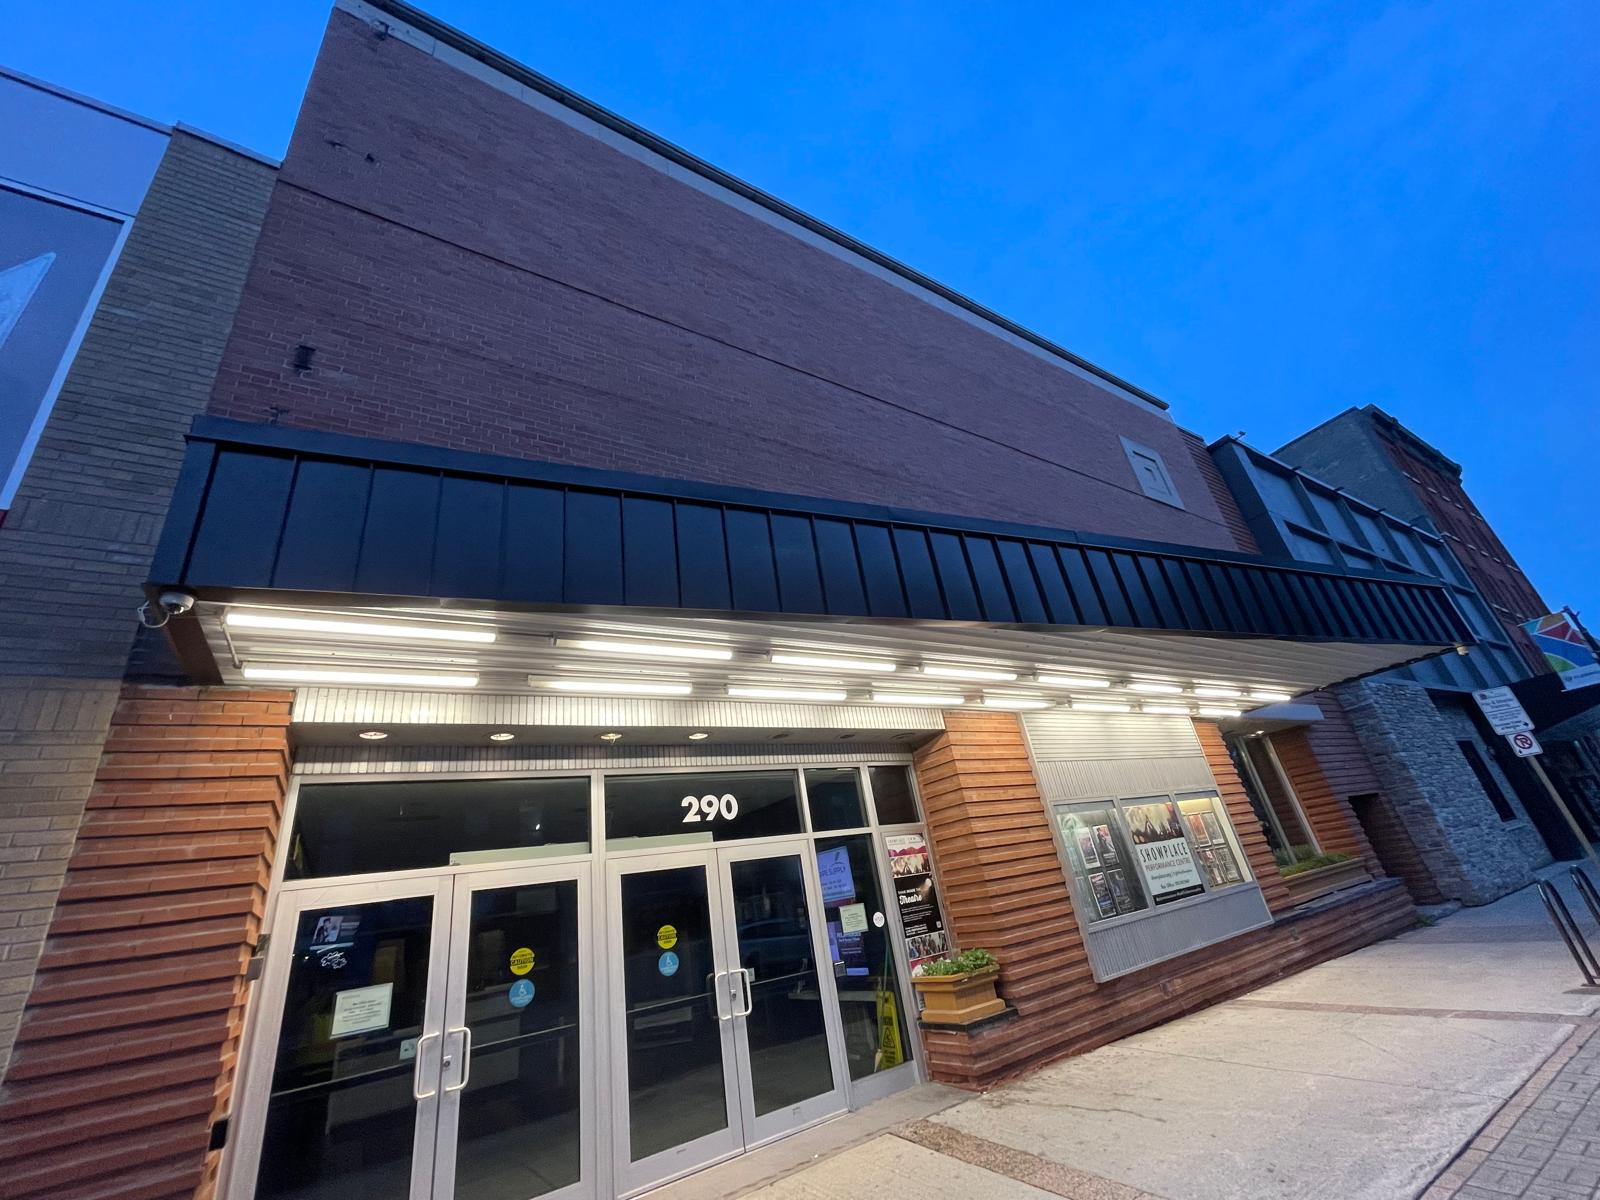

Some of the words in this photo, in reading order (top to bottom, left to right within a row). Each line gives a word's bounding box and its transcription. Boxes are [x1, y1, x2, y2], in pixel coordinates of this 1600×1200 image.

[681, 793, 739, 823] 290
[1140, 842, 1189, 862] SHOWPLACE
[899, 894, 923, 905] Theatre
